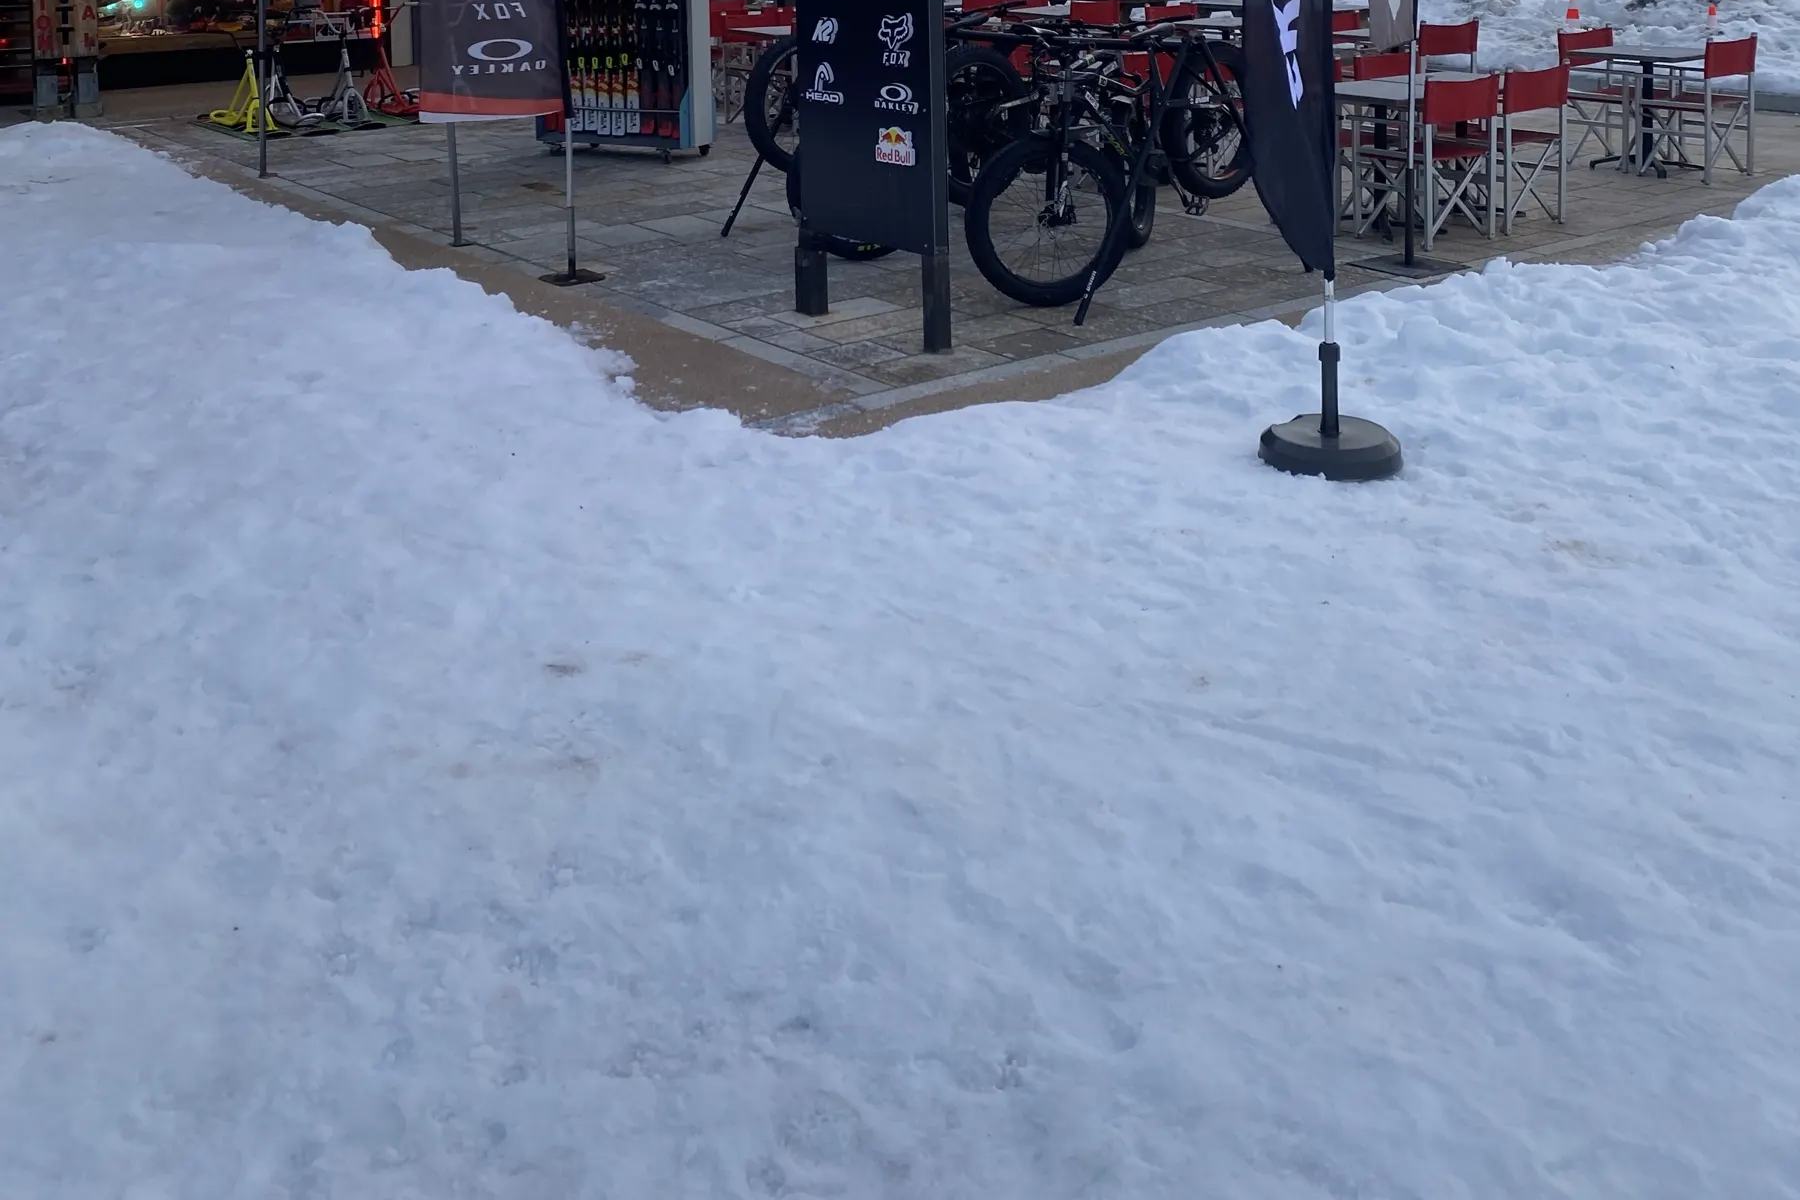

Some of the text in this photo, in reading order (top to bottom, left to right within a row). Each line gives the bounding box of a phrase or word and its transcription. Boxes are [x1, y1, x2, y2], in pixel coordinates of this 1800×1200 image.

[812, 19, 834, 42] K2
[883, 52, 905, 65] FOX
[805, 91, 839, 103] HEAD
[874, 100, 915, 112] OAKLEY
[876, 147, 911, 164] Red Bull
